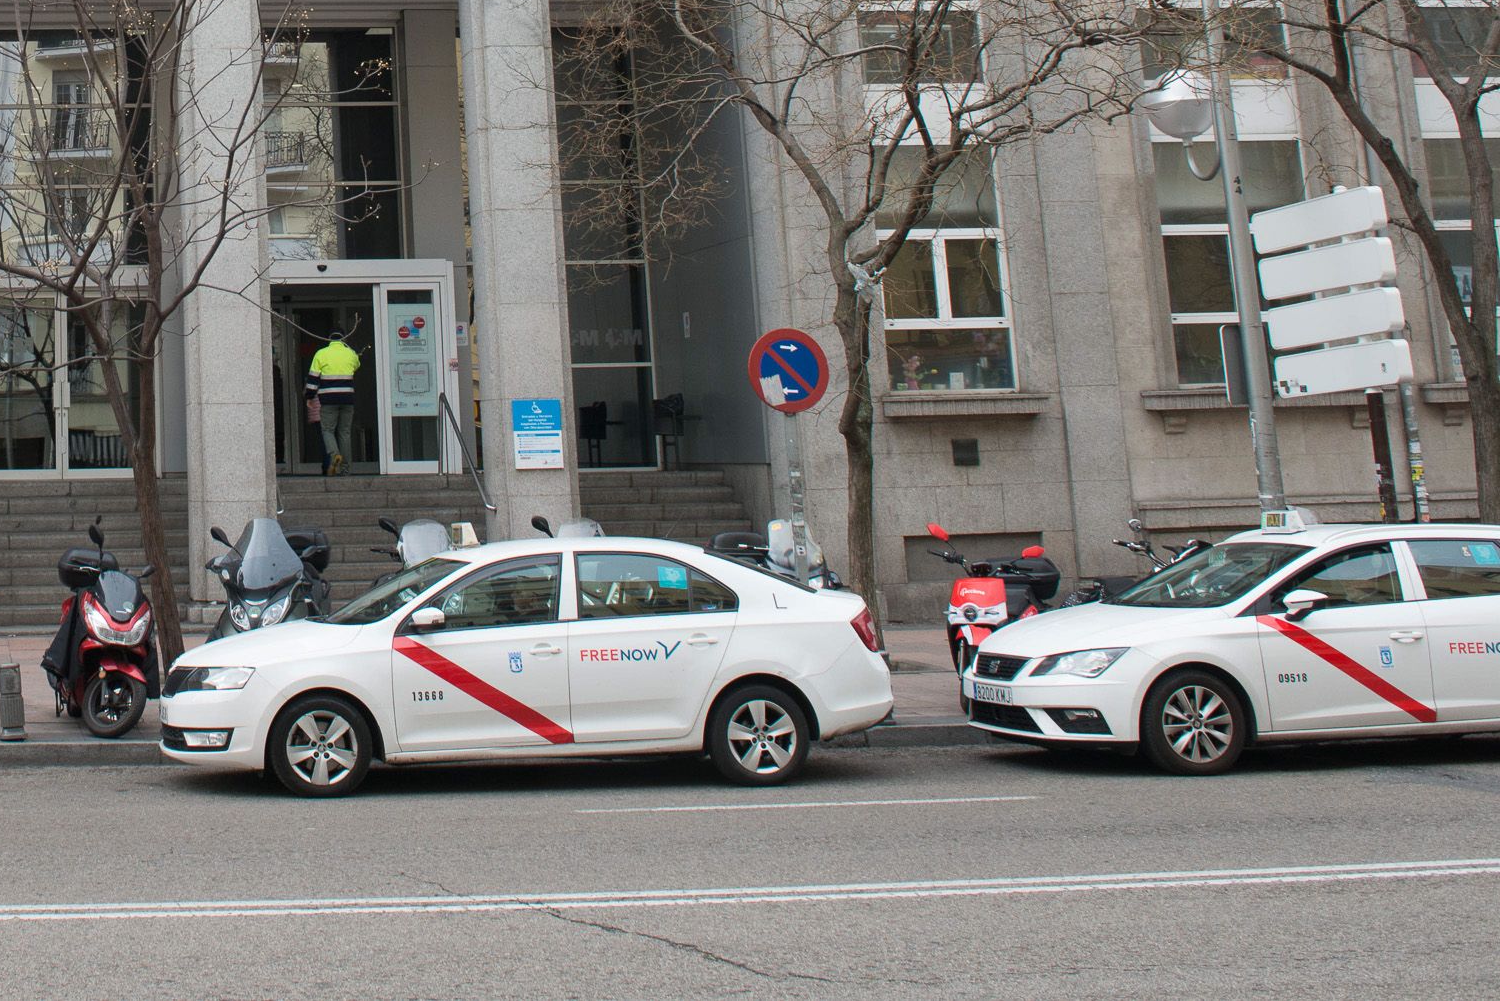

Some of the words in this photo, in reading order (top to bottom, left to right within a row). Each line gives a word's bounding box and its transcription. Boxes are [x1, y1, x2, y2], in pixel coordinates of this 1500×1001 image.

[580, 649, 658, 661] FREENOW
[1278, 673, 1308, 683] 09518
[412, 690, 444, 701] 13668
